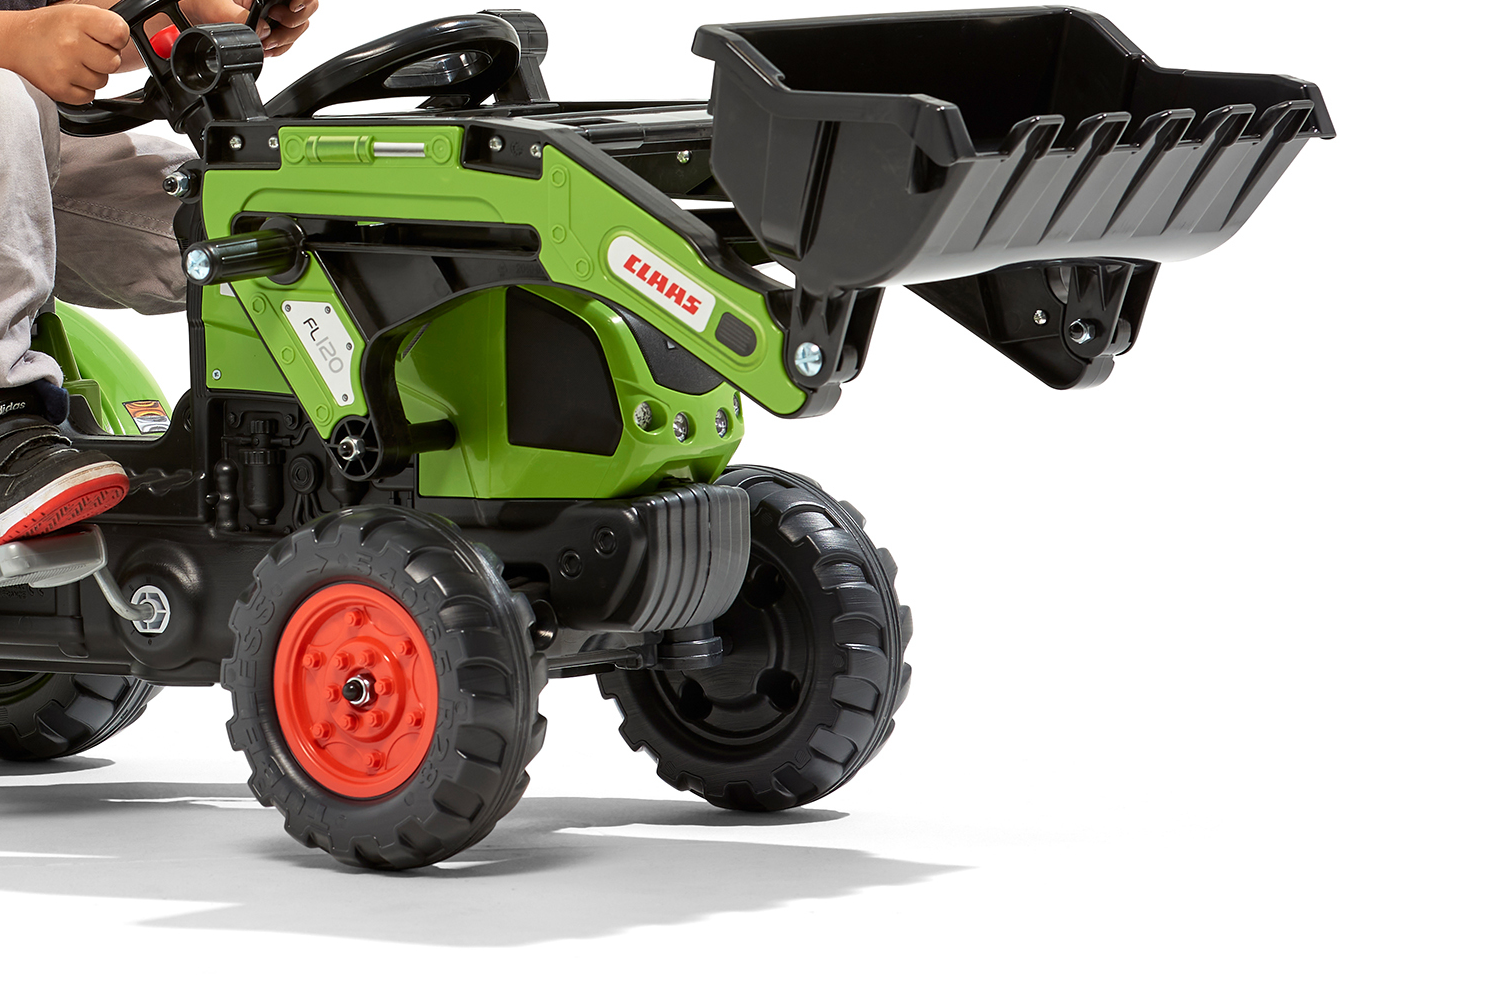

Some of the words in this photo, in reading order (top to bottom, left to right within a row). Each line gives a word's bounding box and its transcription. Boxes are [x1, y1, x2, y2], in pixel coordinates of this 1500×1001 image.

[623, 254, 702, 315] CLAAS
[238, 596, 331, 832] TUBELESS
[419, 701, 455, 790] R28
